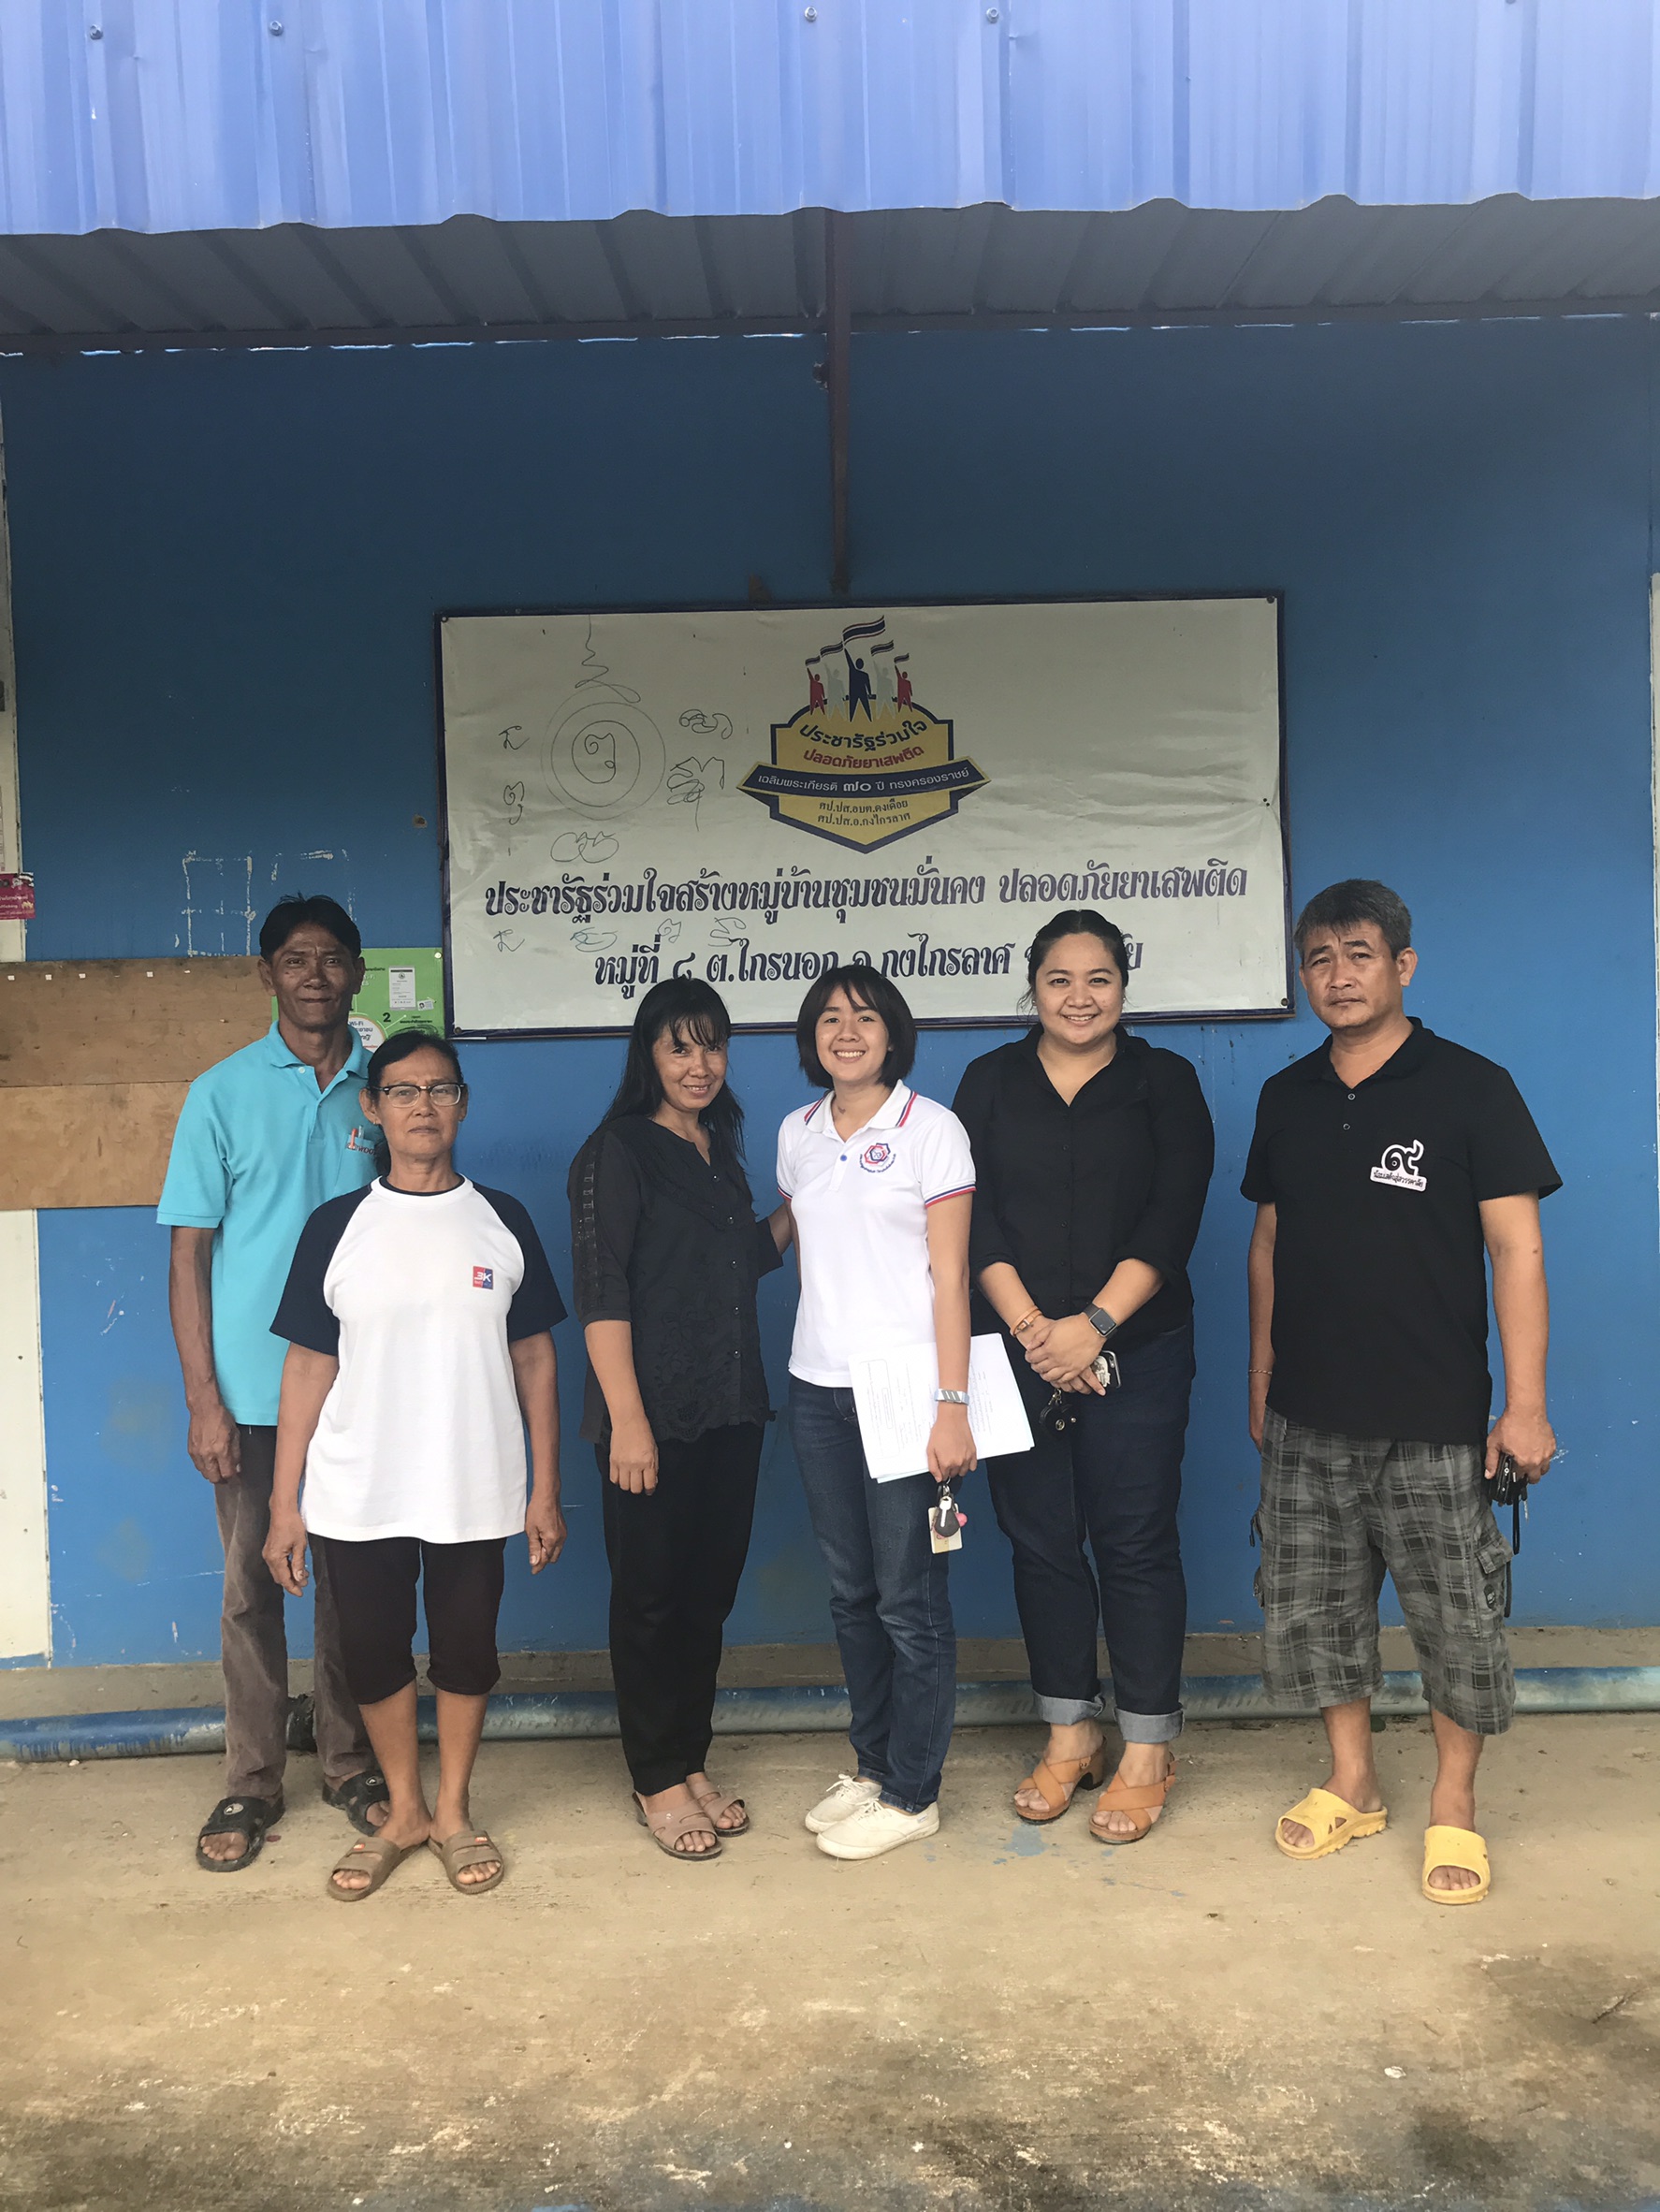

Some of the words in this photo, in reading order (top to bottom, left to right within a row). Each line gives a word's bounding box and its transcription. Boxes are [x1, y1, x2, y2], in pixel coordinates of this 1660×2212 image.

[799, 720, 928, 751] ประชารัฐร่วมใจ
[803, 746, 925, 768] ปลอดภัยยาเสพติด
[758, 775, 838, 792] เฉลิมพระเกียรติ
[843, 780, 872, 793] ๗๐
[875, 780, 885, 791] ปี
[889, 767, 969, 790] ทรงครองราชย์
[485, 855, 985, 924] ประชารัฐร่วมใจสร้างหมู่บ้านชุมชนมั่นคง
[998, 857, 1247, 903] ปลอดภัยยาเสพติด
[595, 934, 661, 1000] หมู่ที่
[706, 938, 839, 982] ต.ไกรนอก
[852, 932, 1016, 979] อกงไกรลาศ
[382, 1011, 391, 1023] 2
[473, 1271, 492, 1283] 3K
